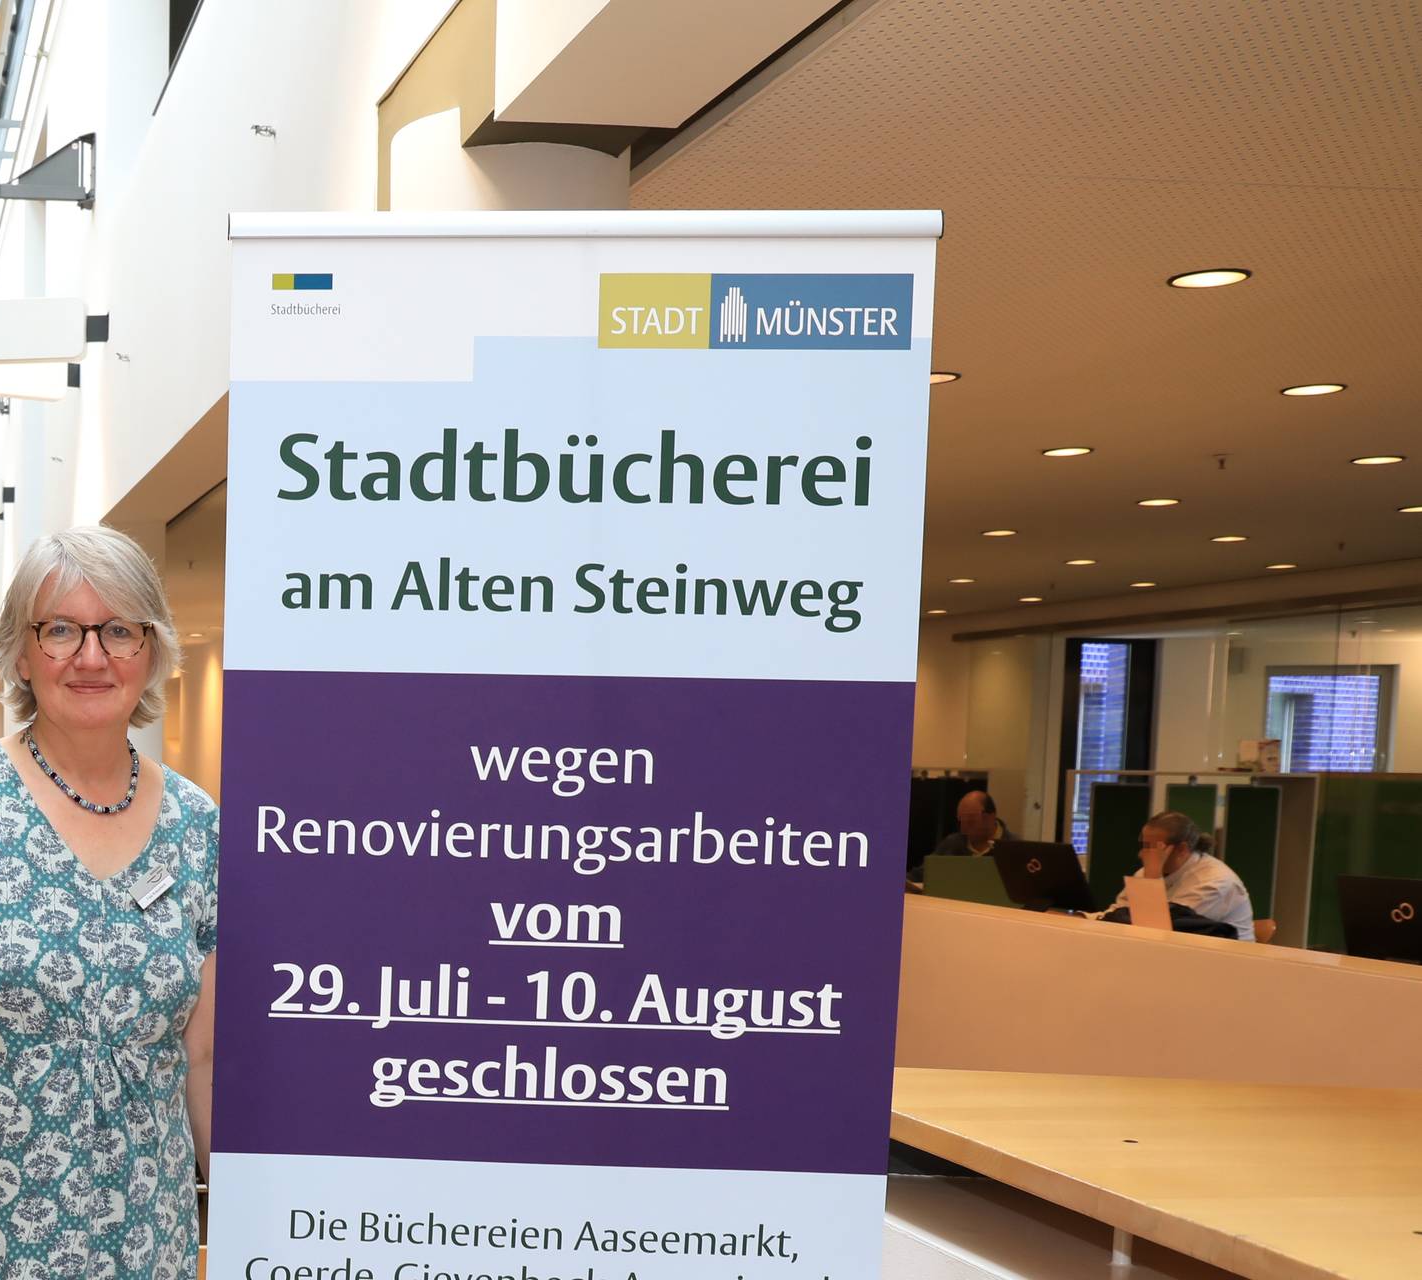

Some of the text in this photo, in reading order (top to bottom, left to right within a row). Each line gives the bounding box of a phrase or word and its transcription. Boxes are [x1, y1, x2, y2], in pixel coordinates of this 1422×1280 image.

[270, 302, 341, 316] Stadtbücherei
[610, 300, 898, 336] STADT MÜNSTER
[276, 427, 873, 507] Stadtbücherei
[281, 556, 864, 634] am Alten Steinweg
[470, 745, 654, 797] wegen
[257, 805, 868, 875] Renovierungsarbeiten
[489, 902, 623, 943] vom
[270, 962, 843, 1039] 29. Juli - 10. August
[369, 1044, 728, 1108] geschlossen
[289, 1209, 798, 1264] Die Büchereien Aaseemarkt,
